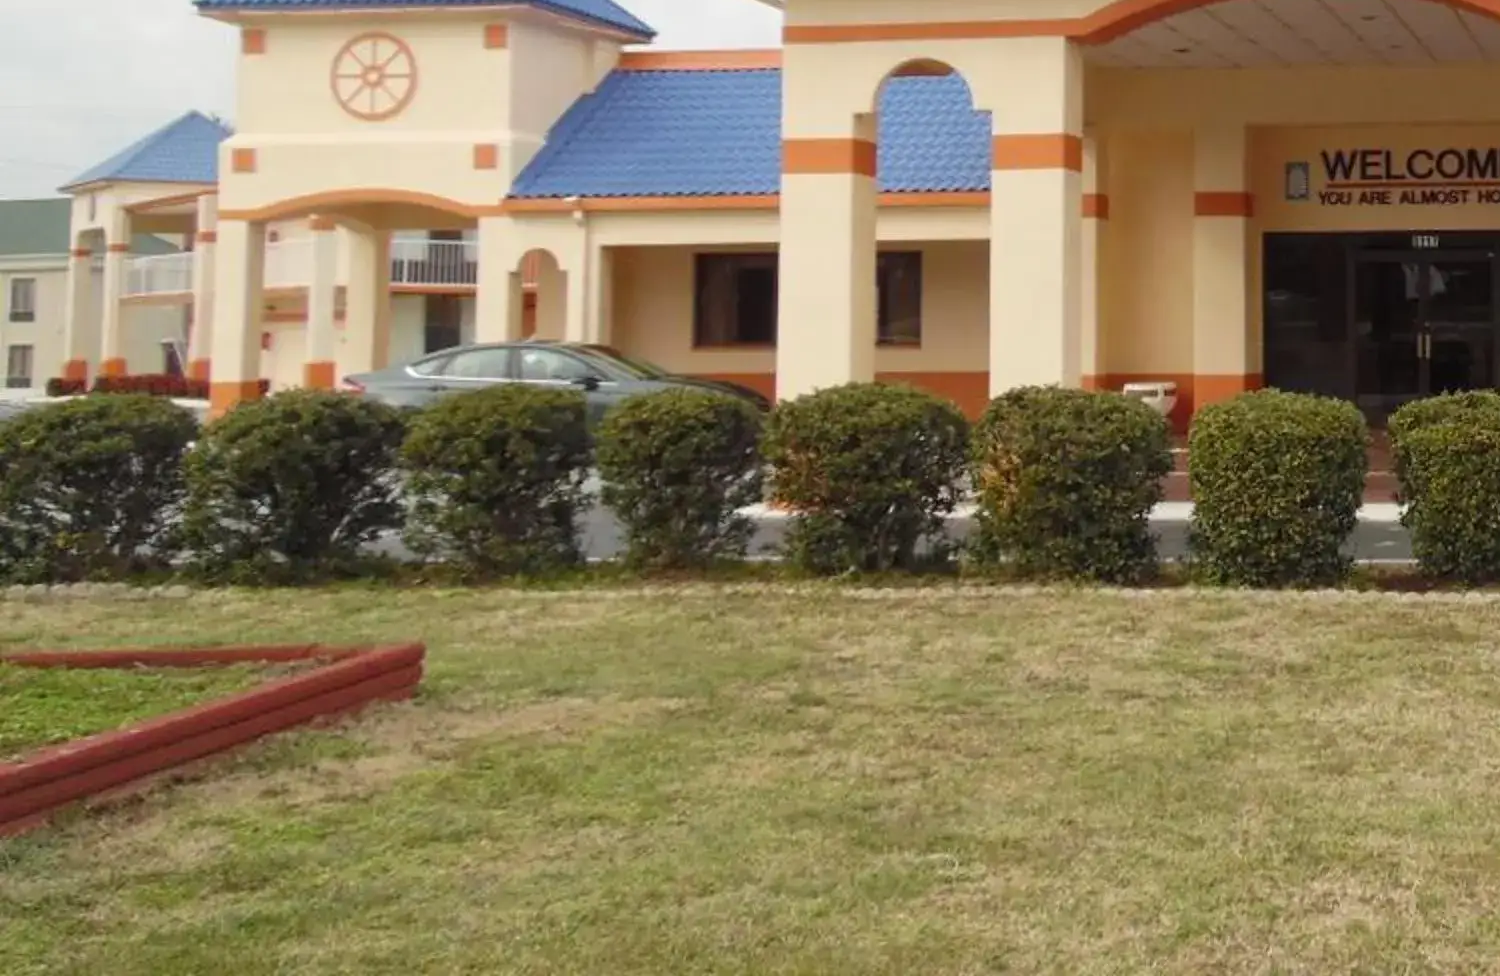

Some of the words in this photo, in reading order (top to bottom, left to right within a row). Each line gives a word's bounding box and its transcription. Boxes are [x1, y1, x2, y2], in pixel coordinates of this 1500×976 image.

[1319, 191, 1352, 205] YOU
[1359, 191, 1392, 205] ARE
[1400, 190, 1468, 204] ALMOST
